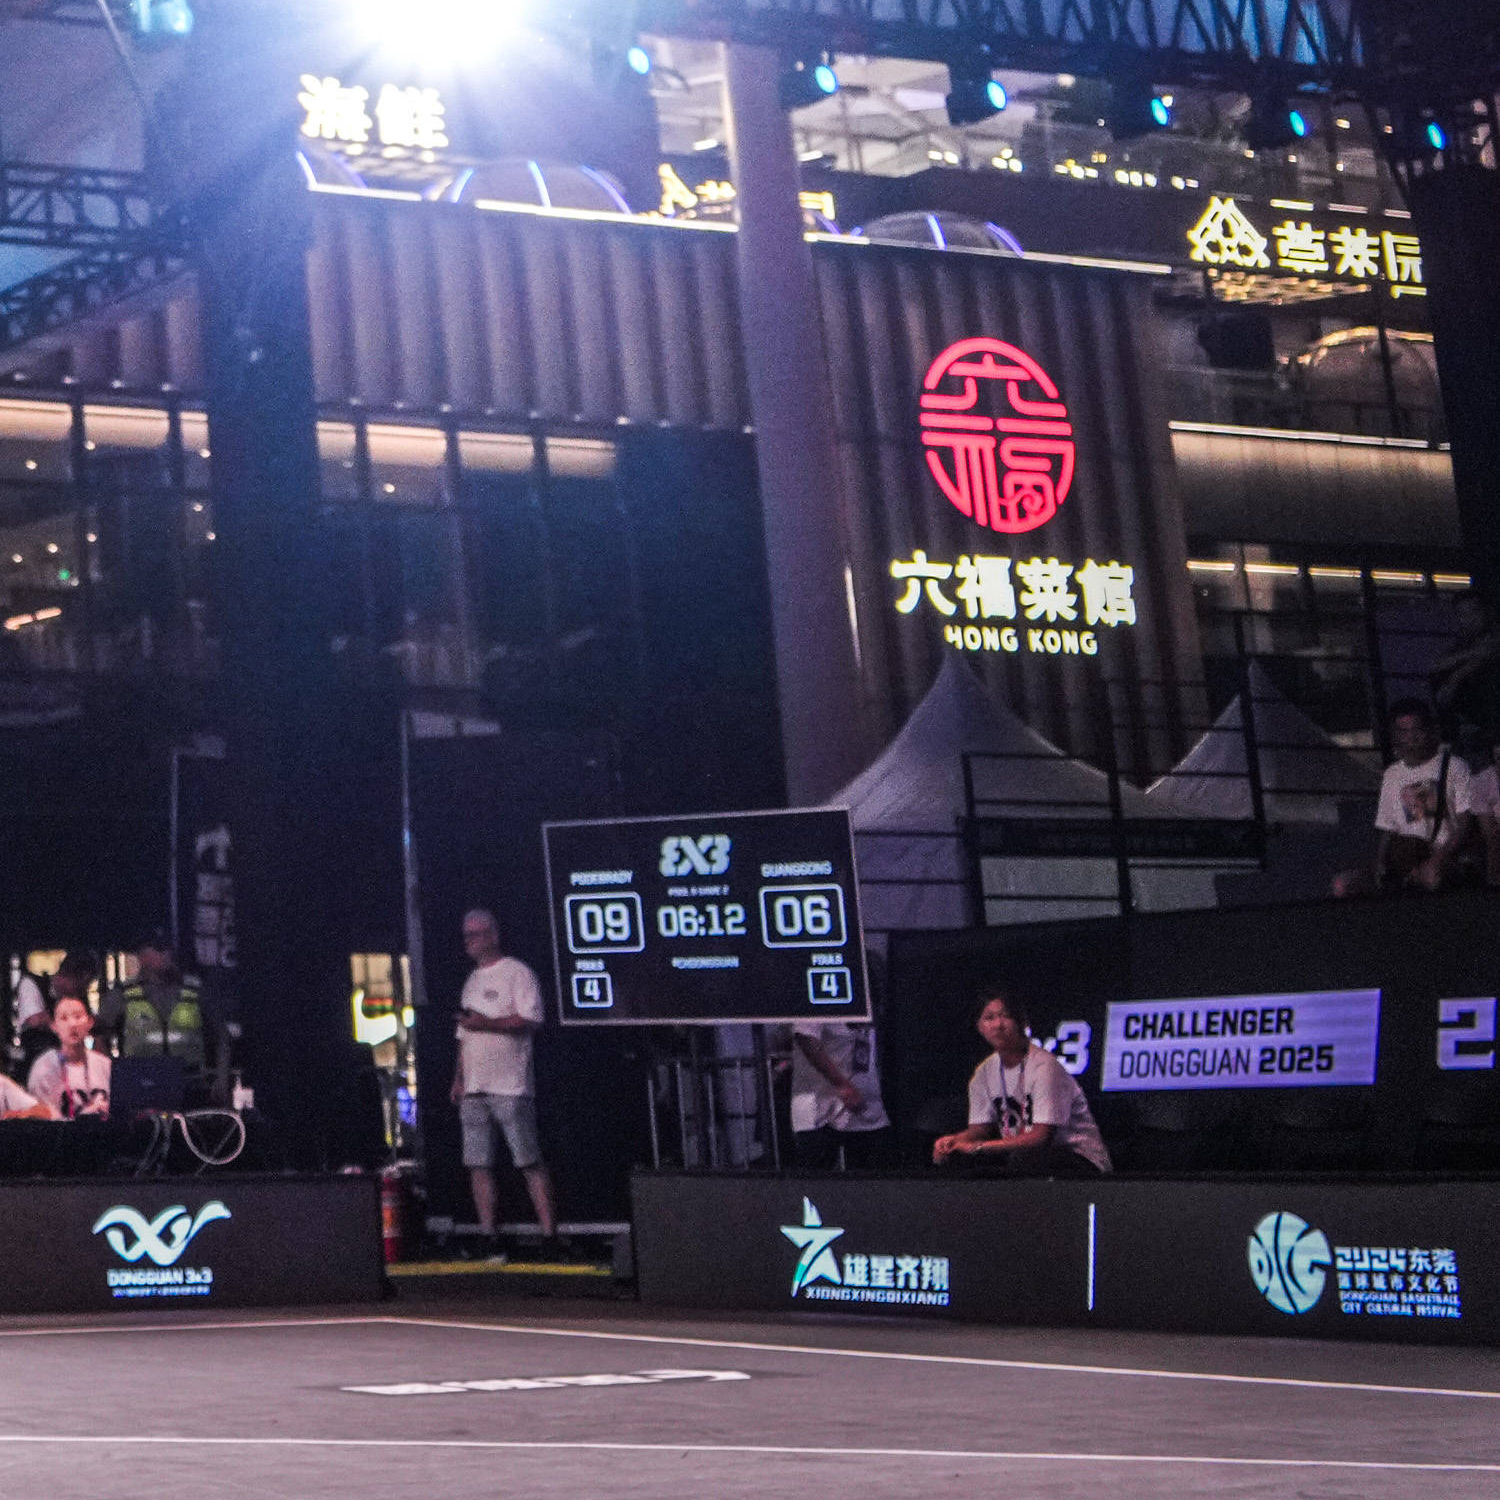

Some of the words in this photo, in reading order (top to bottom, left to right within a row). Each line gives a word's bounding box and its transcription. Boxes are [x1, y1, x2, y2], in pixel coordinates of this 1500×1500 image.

[889, 549, 1137, 627] 六福菜馆
[944, 625, 1019, 652] HONG
[1027, 628, 1099, 656] KONG
[578, 902, 632, 943] 09
[657, 903, 747, 938] 06:12
[773, 895, 833, 937] 06
[583, 978, 601, 1002] 4
[821, 973, 840, 999] 4
[1123, 1008, 1296, 1040] CHALLENGER
[1119, 1046, 1252, 1079] DONGGUAN
[1258, 1045, 1335, 1075] 2025
[107, 1268, 184, 1288] DONGGUAN
